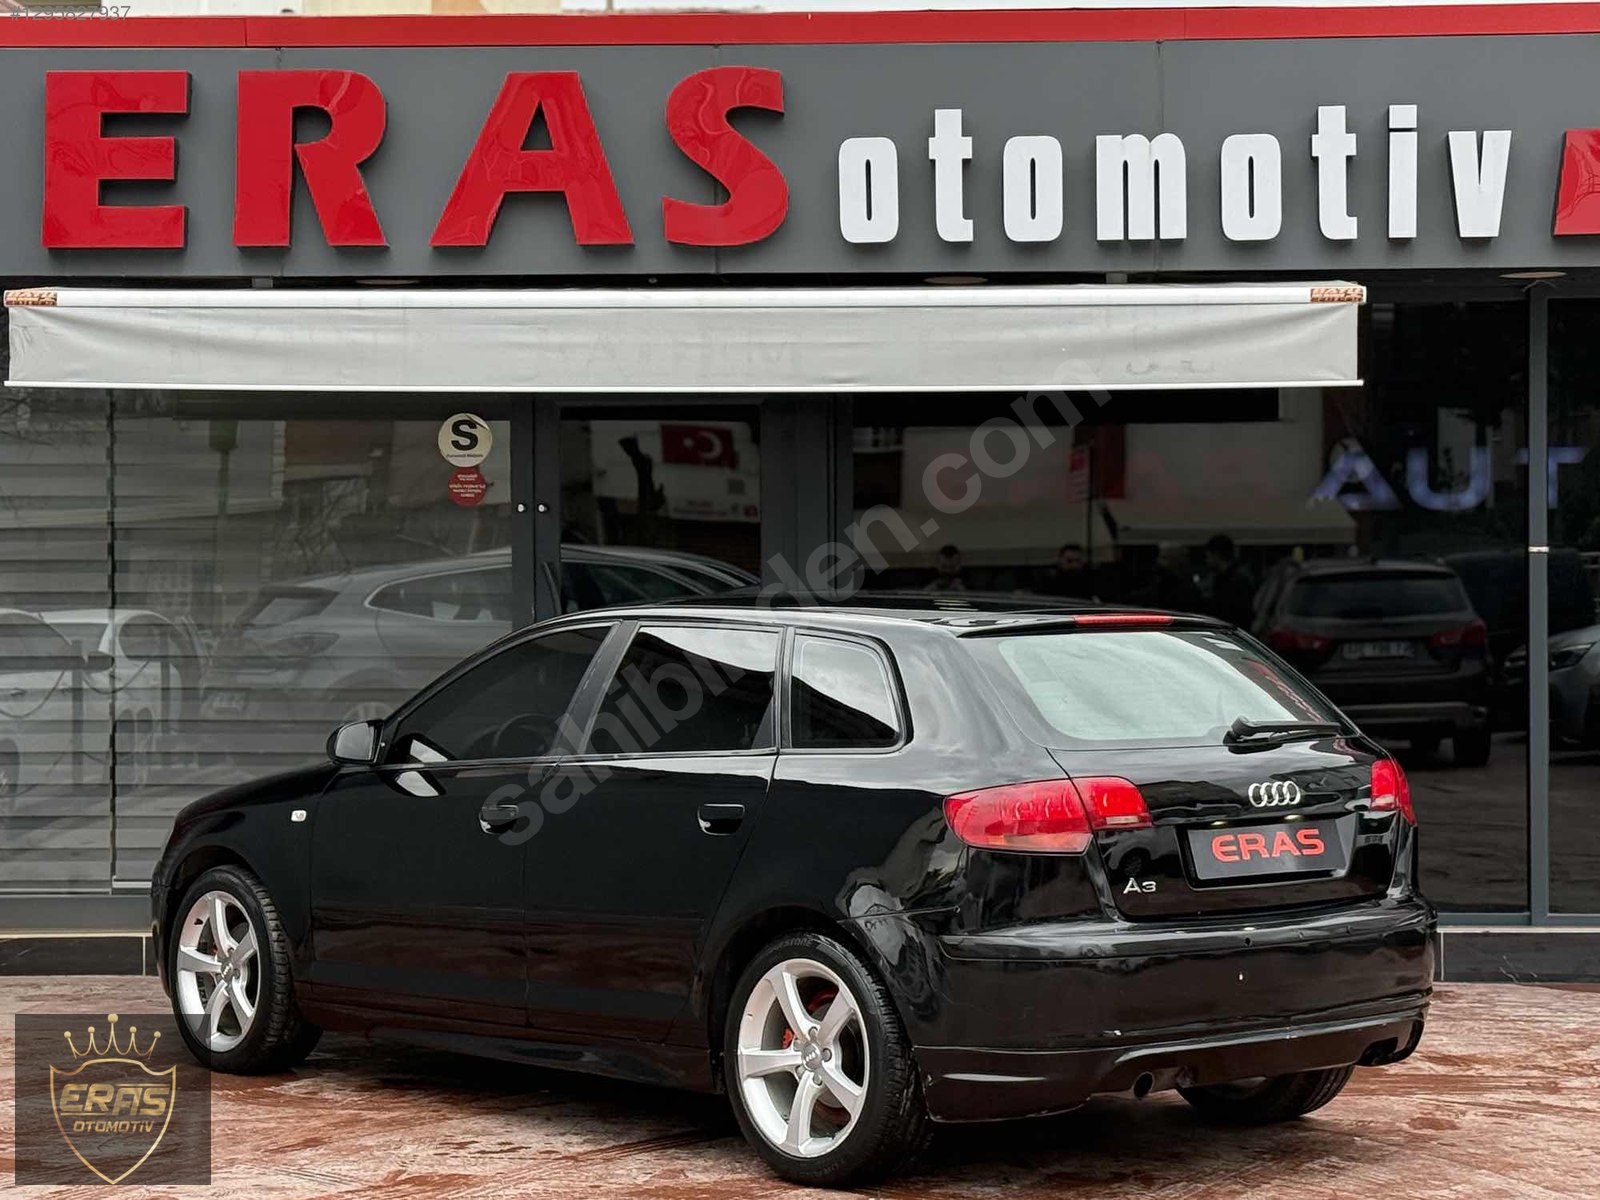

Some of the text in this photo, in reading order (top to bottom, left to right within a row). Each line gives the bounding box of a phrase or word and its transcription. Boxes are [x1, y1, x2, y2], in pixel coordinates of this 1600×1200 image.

[42, 66, 1512, 249] ERAS otomotiv
[451, 419, 478, 451] S
[1211, 828, 1326, 863] ERAS
[1122, 877, 1158, 895] A3
